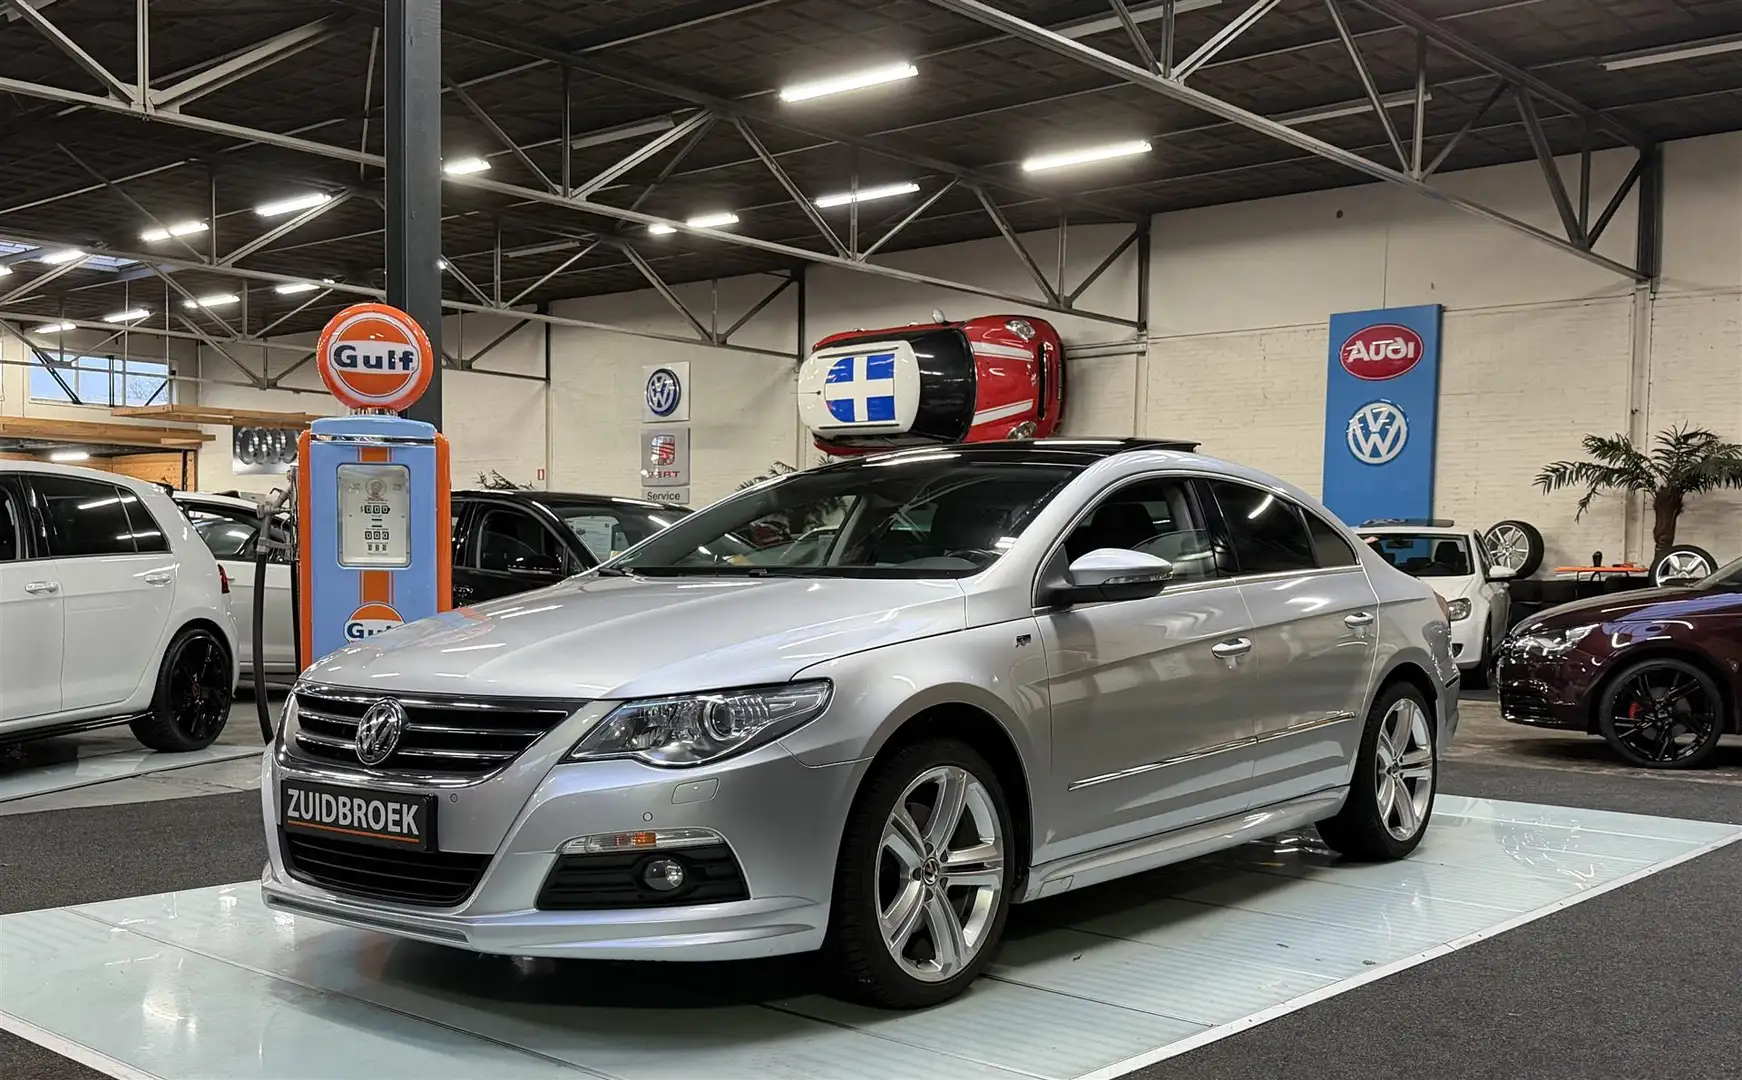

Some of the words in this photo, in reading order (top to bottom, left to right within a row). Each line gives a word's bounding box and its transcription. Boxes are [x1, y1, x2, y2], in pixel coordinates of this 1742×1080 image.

[333, 344, 414, 371] Gulf
[647, 491, 681, 501] Service
[287, 788, 419, 835] ZUIDBROEK
